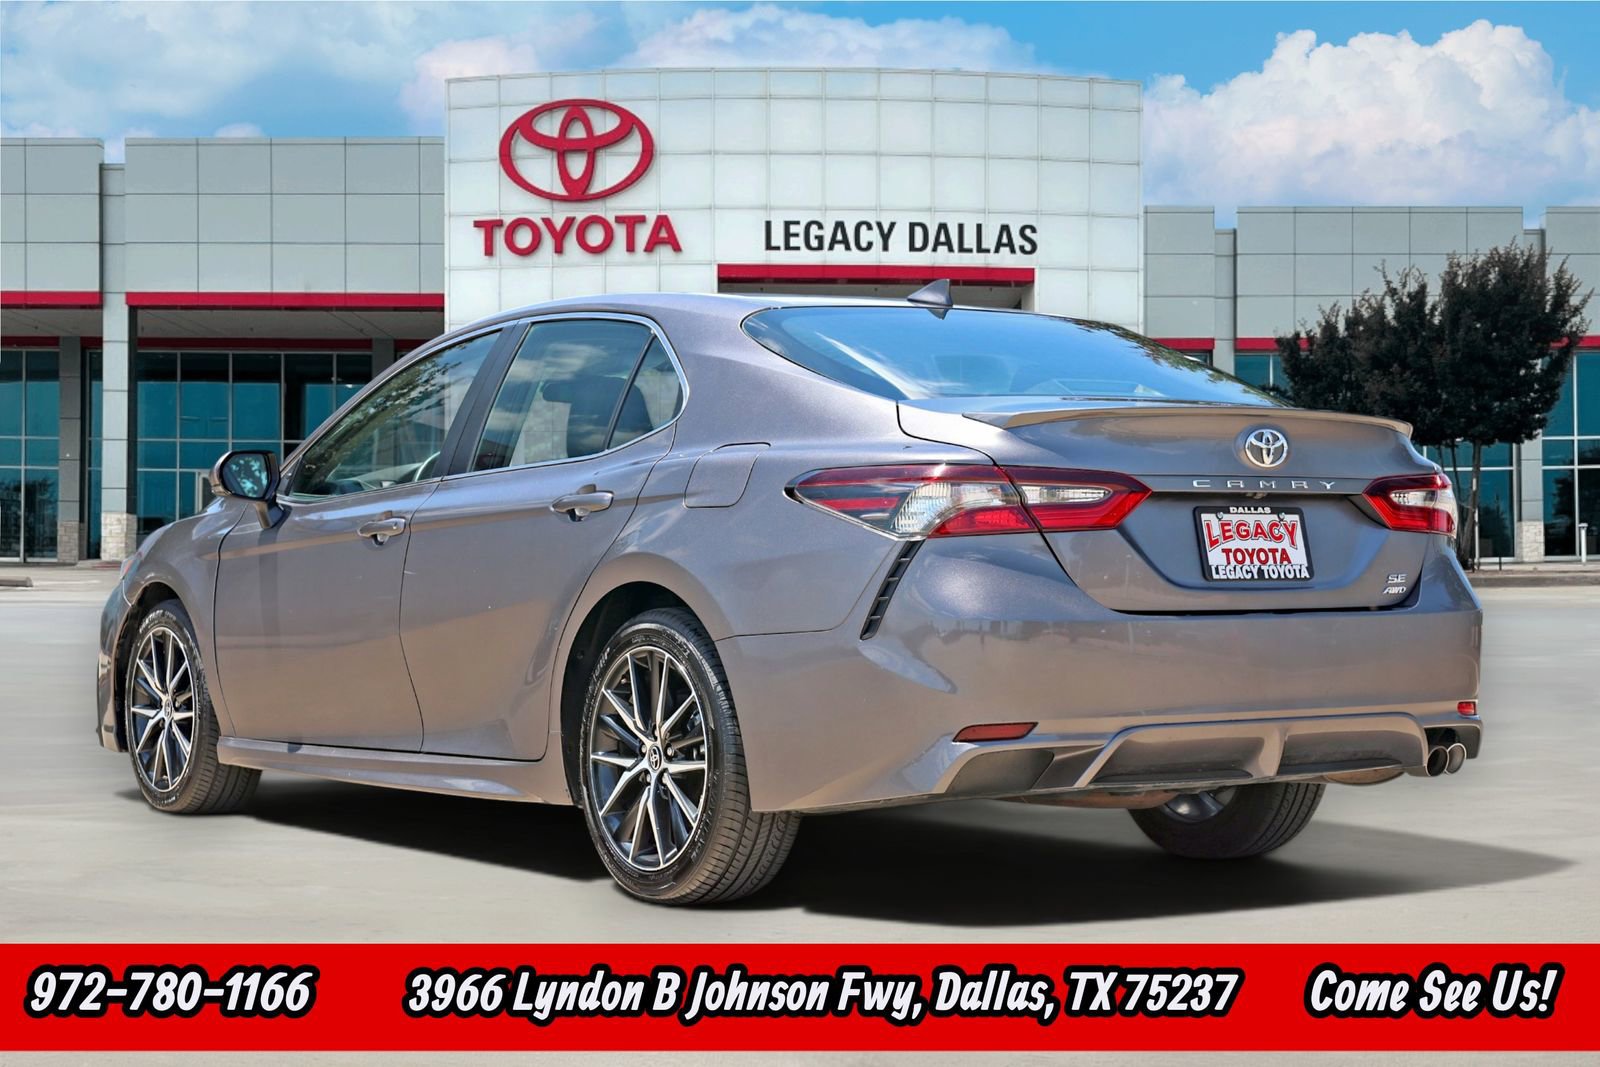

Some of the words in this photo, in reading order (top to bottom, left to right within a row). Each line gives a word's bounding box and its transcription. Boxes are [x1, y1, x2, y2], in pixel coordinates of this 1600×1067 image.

[473, 214, 682, 257] TOYOTA
[764, 220, 897, 252] LEGACY
[908, 221, 1038, 255] DALLAS
[1192, 479, 1336, 490] CAMRY
[1229, 506, 1272, 514] DALLAS
[1204, 520, 1298, 552] LEGACY
[1221, 548, 1292, 566] TOYOTA
[1211, 564, 1262, 579] LEGACY
[1261, 564, 1310, 579] TOYOTA
[1387, 574, 1407, 583] SE
[1383, 586, 1406, 594] AWD
